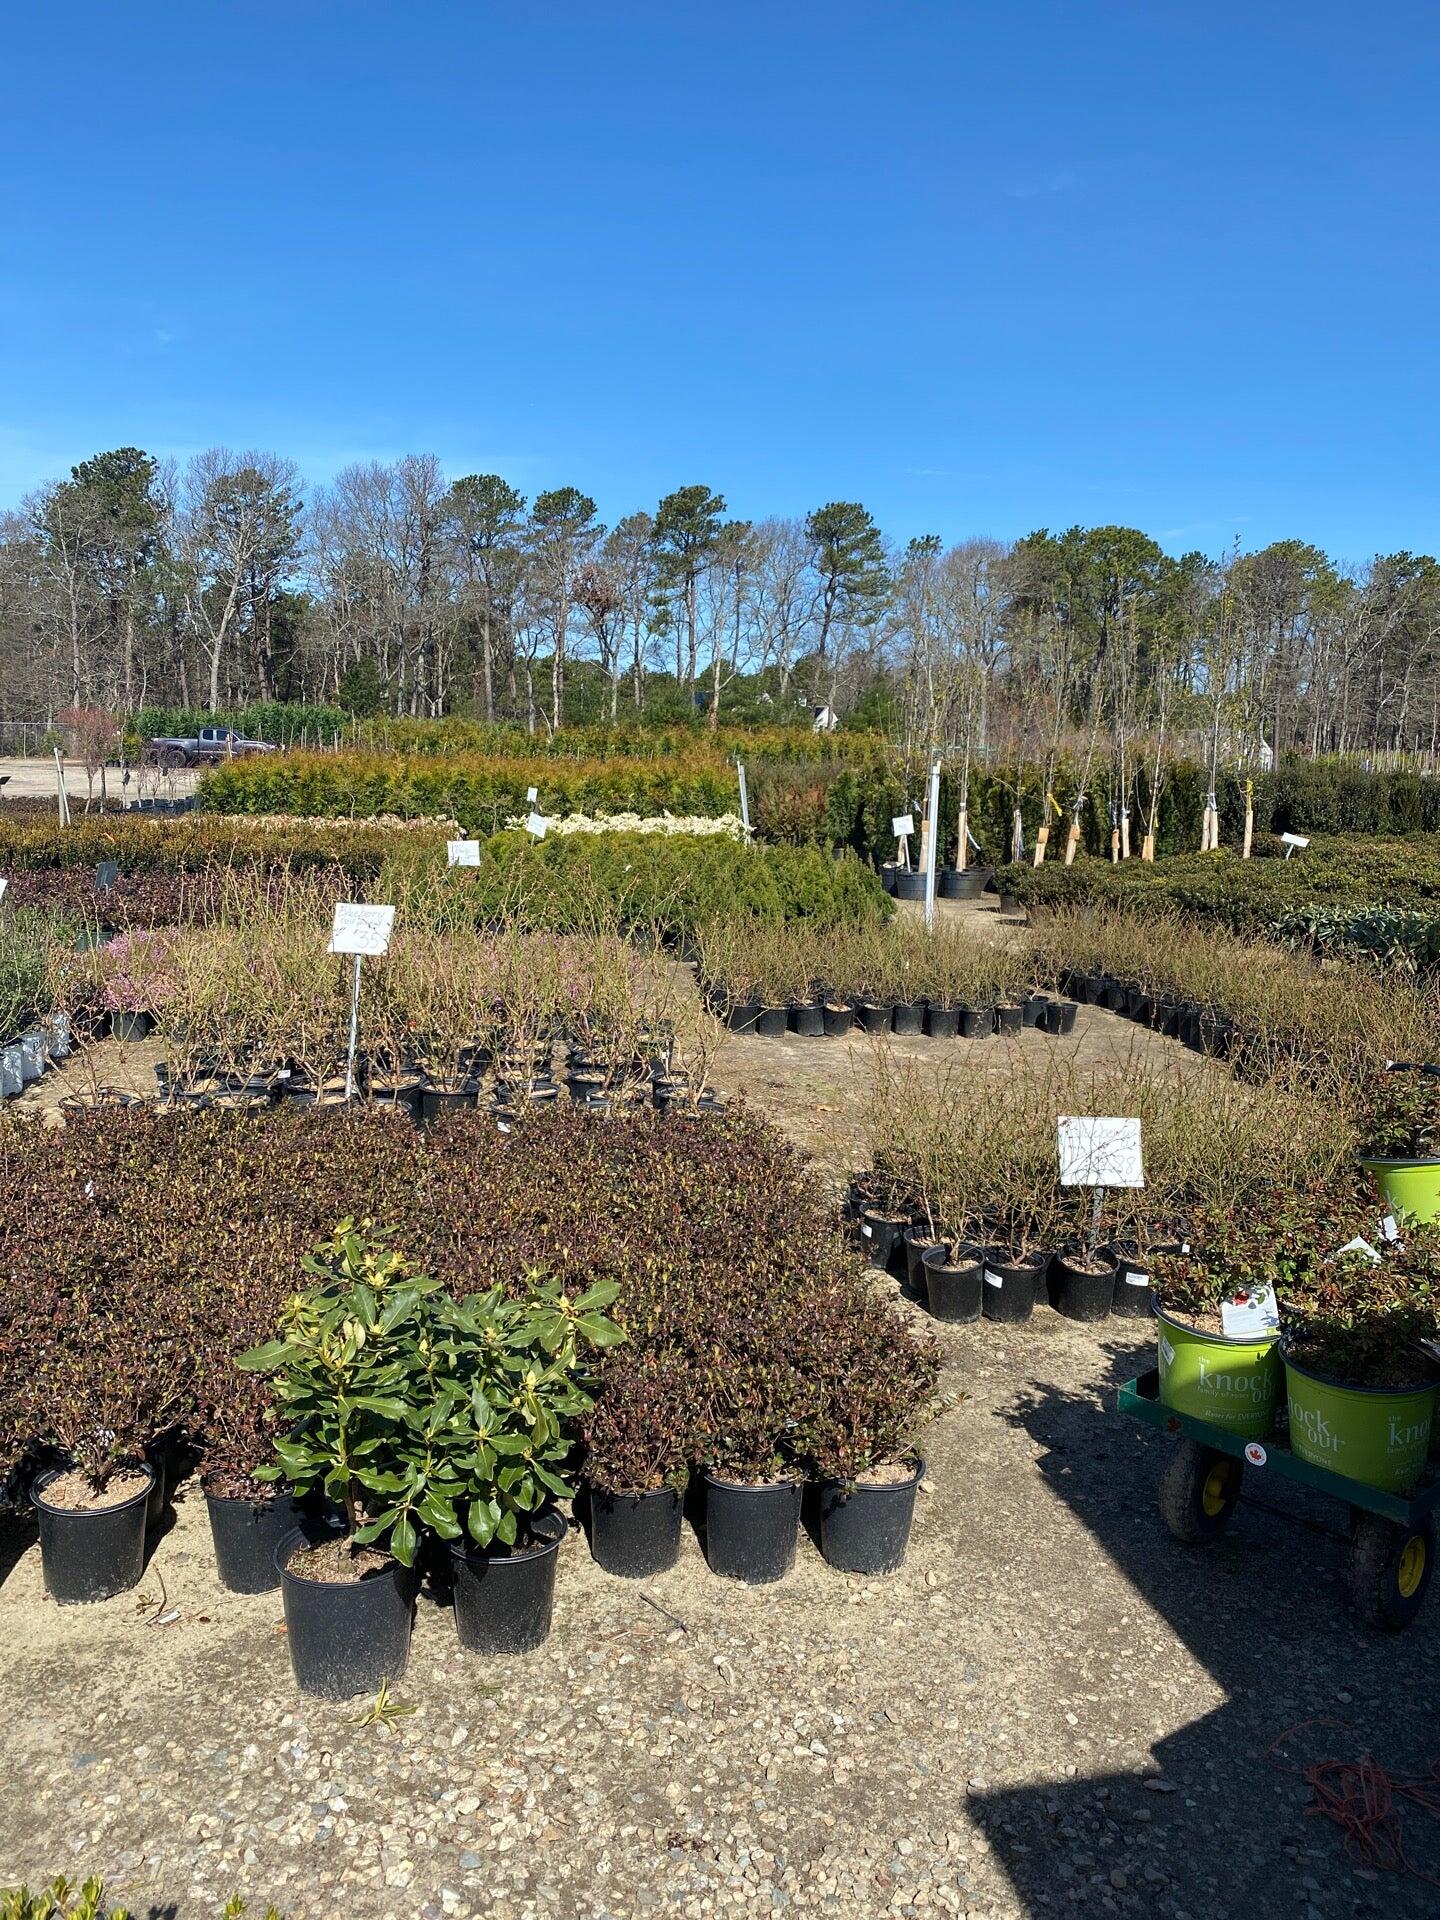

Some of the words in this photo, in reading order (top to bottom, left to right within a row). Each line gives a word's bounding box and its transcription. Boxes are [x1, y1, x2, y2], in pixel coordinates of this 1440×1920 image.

[1198, 1363, 1275, 1392] knock
[1287, 1395, 1331, 1437] nock
[1308, 1428, 1339, 1452] out
